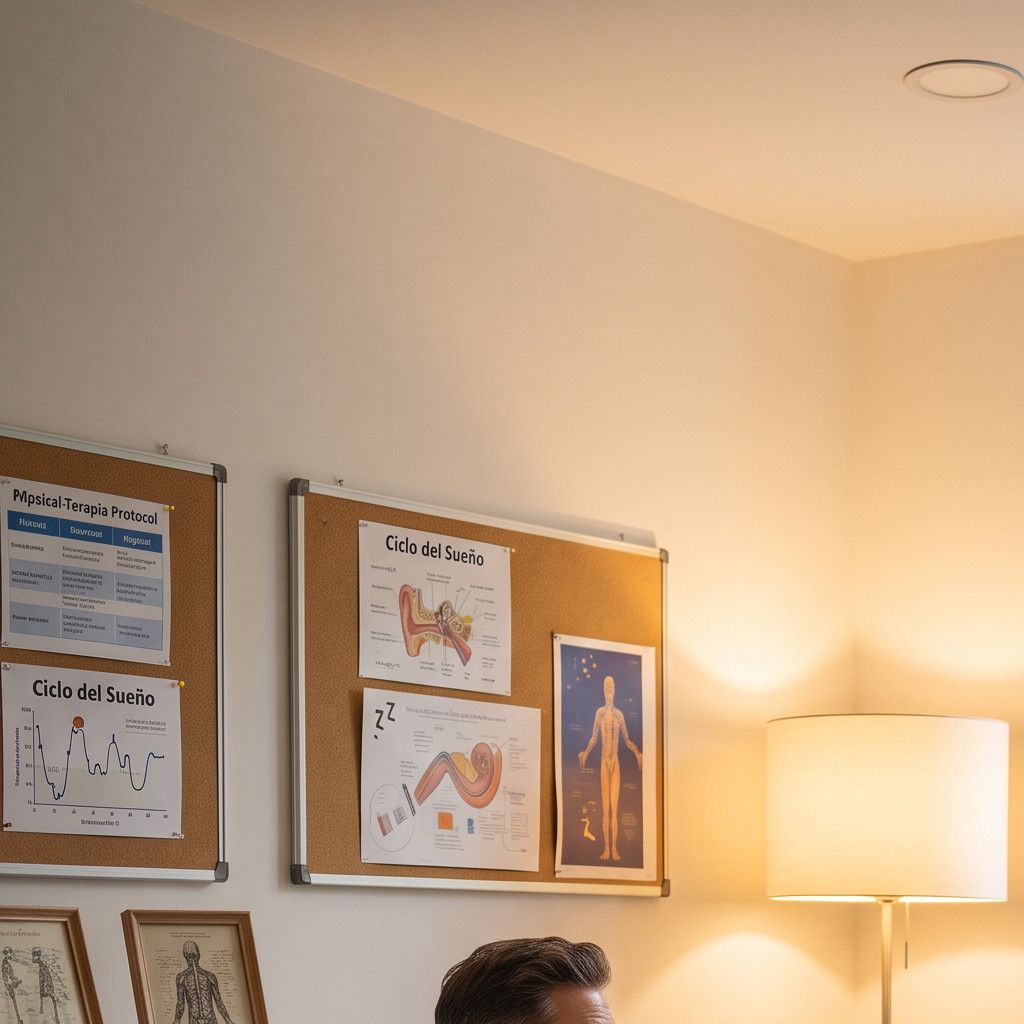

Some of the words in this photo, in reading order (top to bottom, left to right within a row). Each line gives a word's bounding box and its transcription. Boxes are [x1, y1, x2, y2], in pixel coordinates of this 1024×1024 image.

[111, 508, 158, 525] Protocol
[385, 534, 417, 555] Ciclo
[421, 541, 441, 559] del
[445, 545, 484, 567] Sueño
[32, 679, 73, 699] Ciclo
[77, 682, 102, 702] del
[106, 686, 155, 706] Sueño
